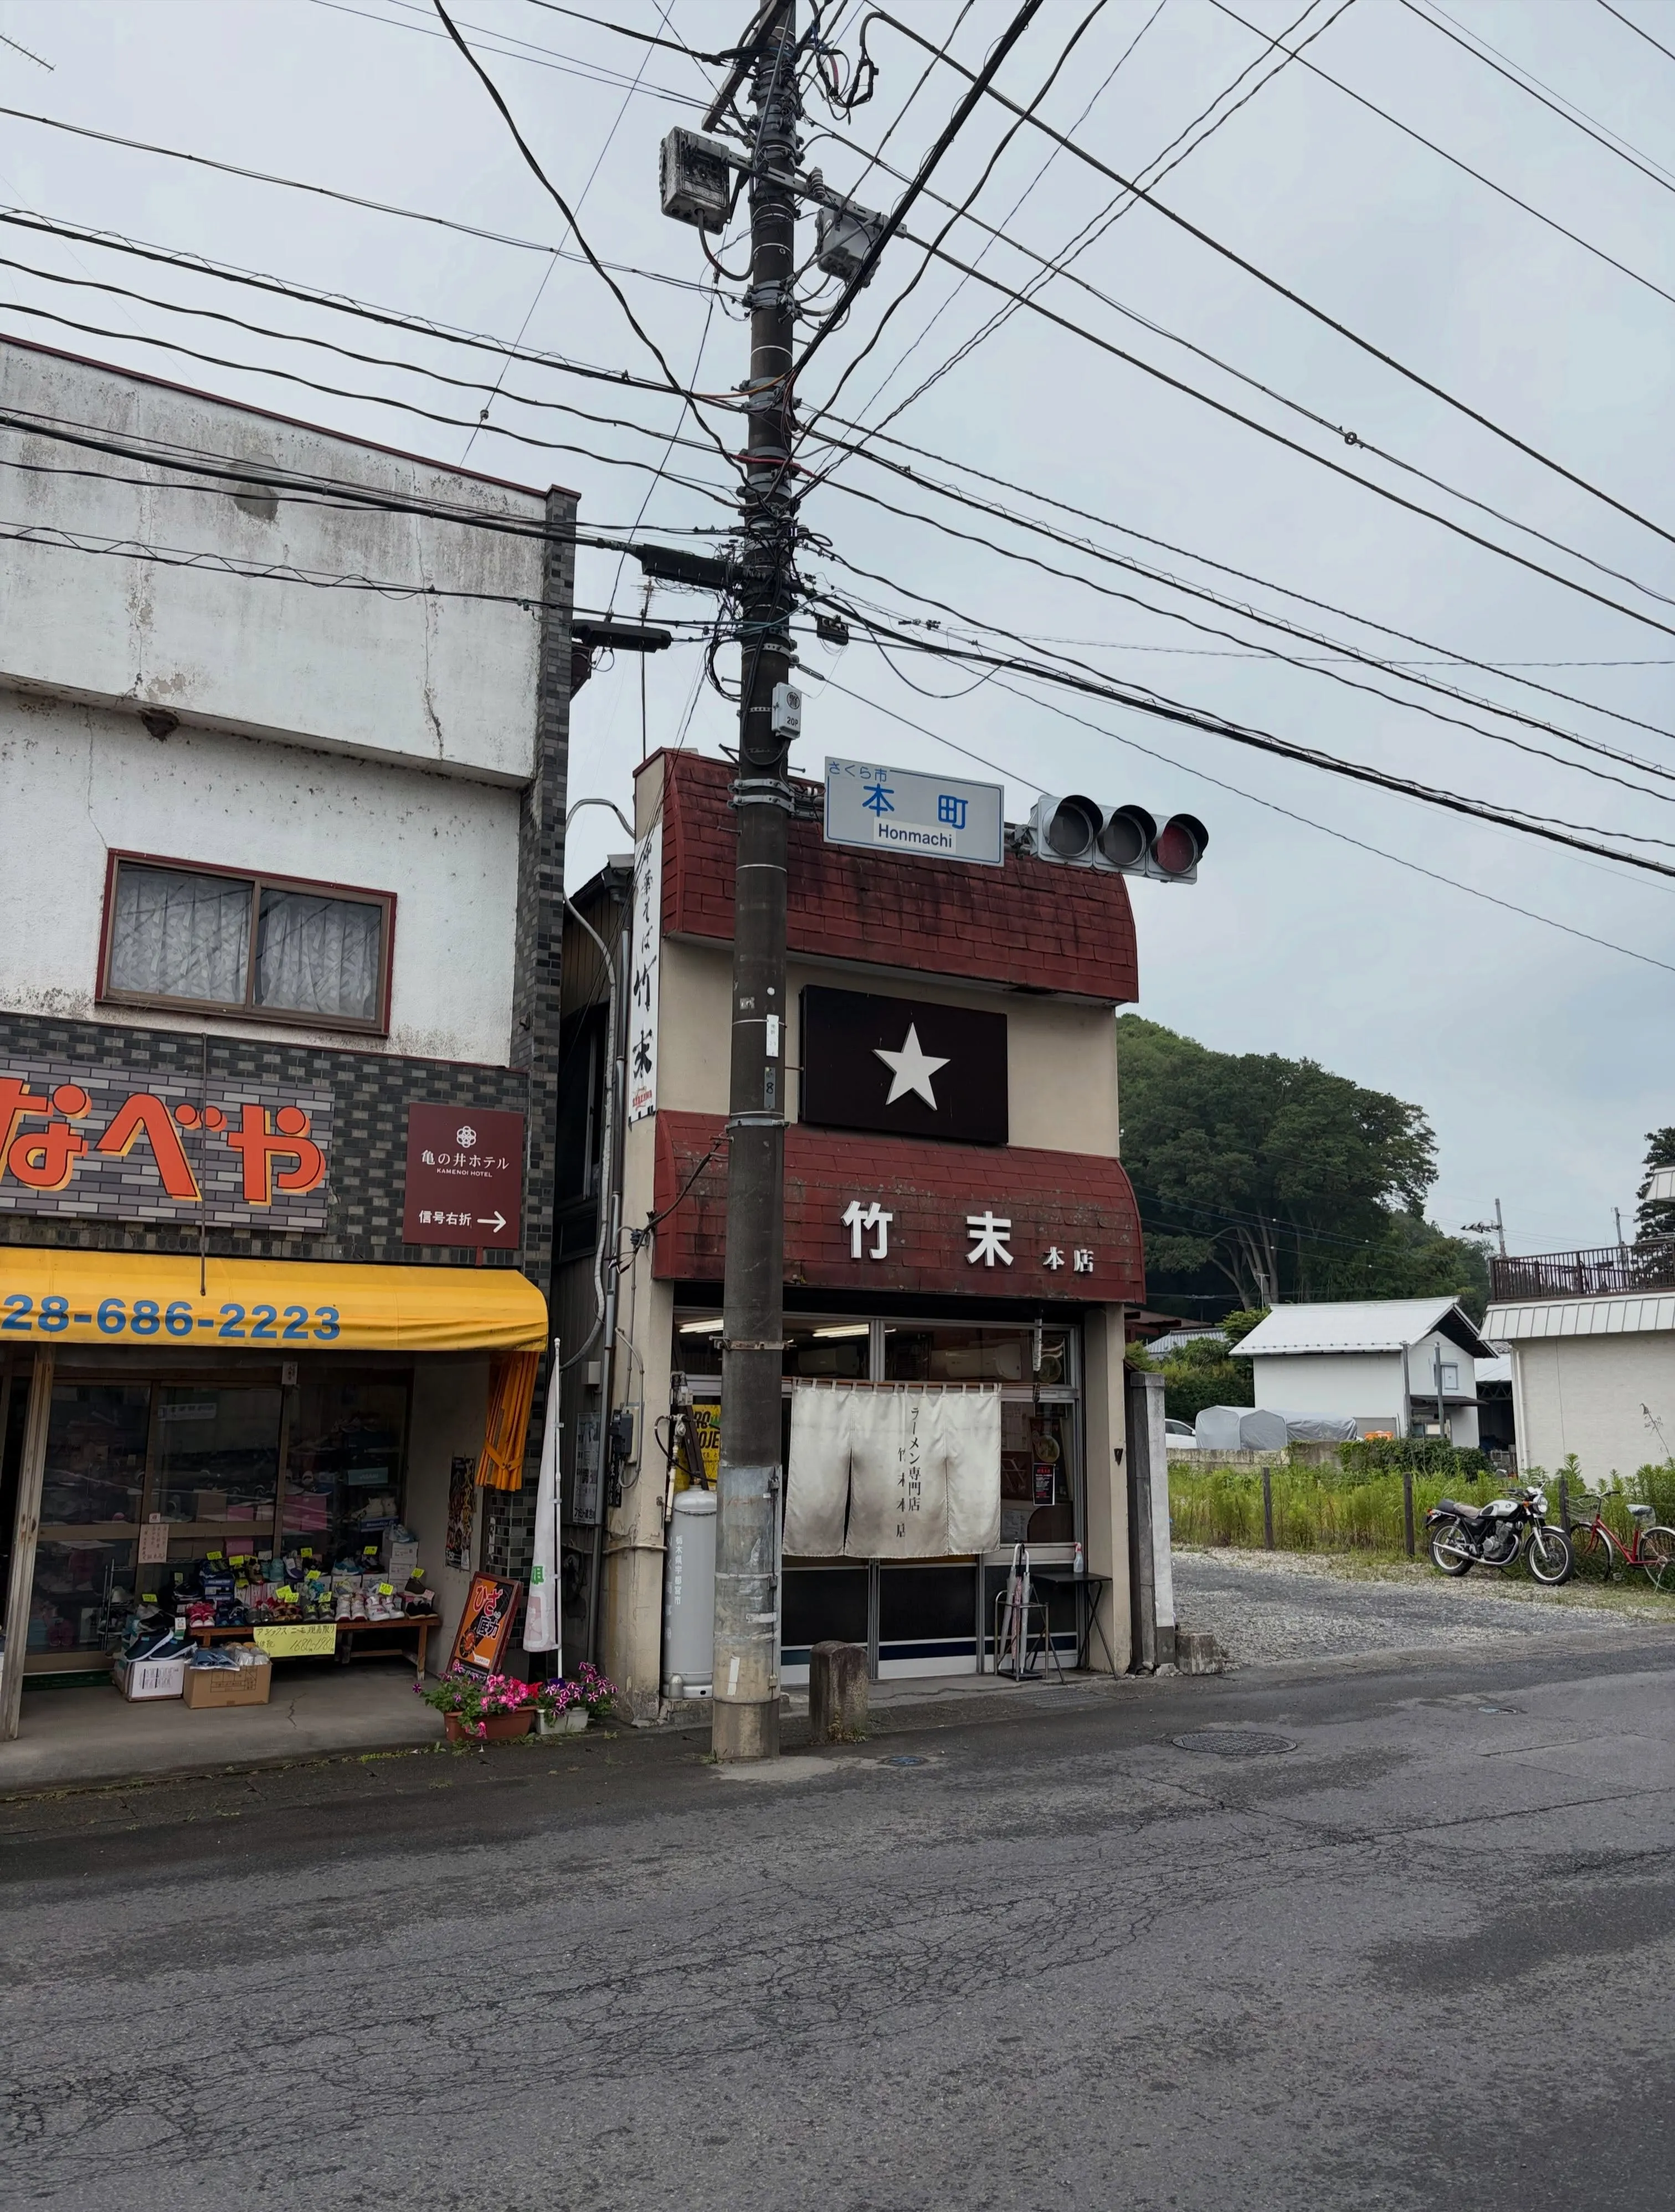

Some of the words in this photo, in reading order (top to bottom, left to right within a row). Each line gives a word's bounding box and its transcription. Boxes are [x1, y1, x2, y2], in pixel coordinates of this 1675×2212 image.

[787, 716, 799, 727] 20P
[829, 761, 887, 783] さくら市
[862, 783, 968, 829] 本町
[878, 823, 952, 848] Honmachi
[0, 1077, 326, 1206] なべや
[421, 1149, 509, 1170] 亀の井ホテル
[419, 1210, 472, 1226] 信号右折
[840, 1200, 1014, 1267] 竹末
[1042, 1246, 1095, 1272] 本店
[1, 1294, 341, 1341] 28-686-2223
[908, 1407, 921, 1512] ラーメン専門店
[474, 1585, 503, 1617] ひざ
